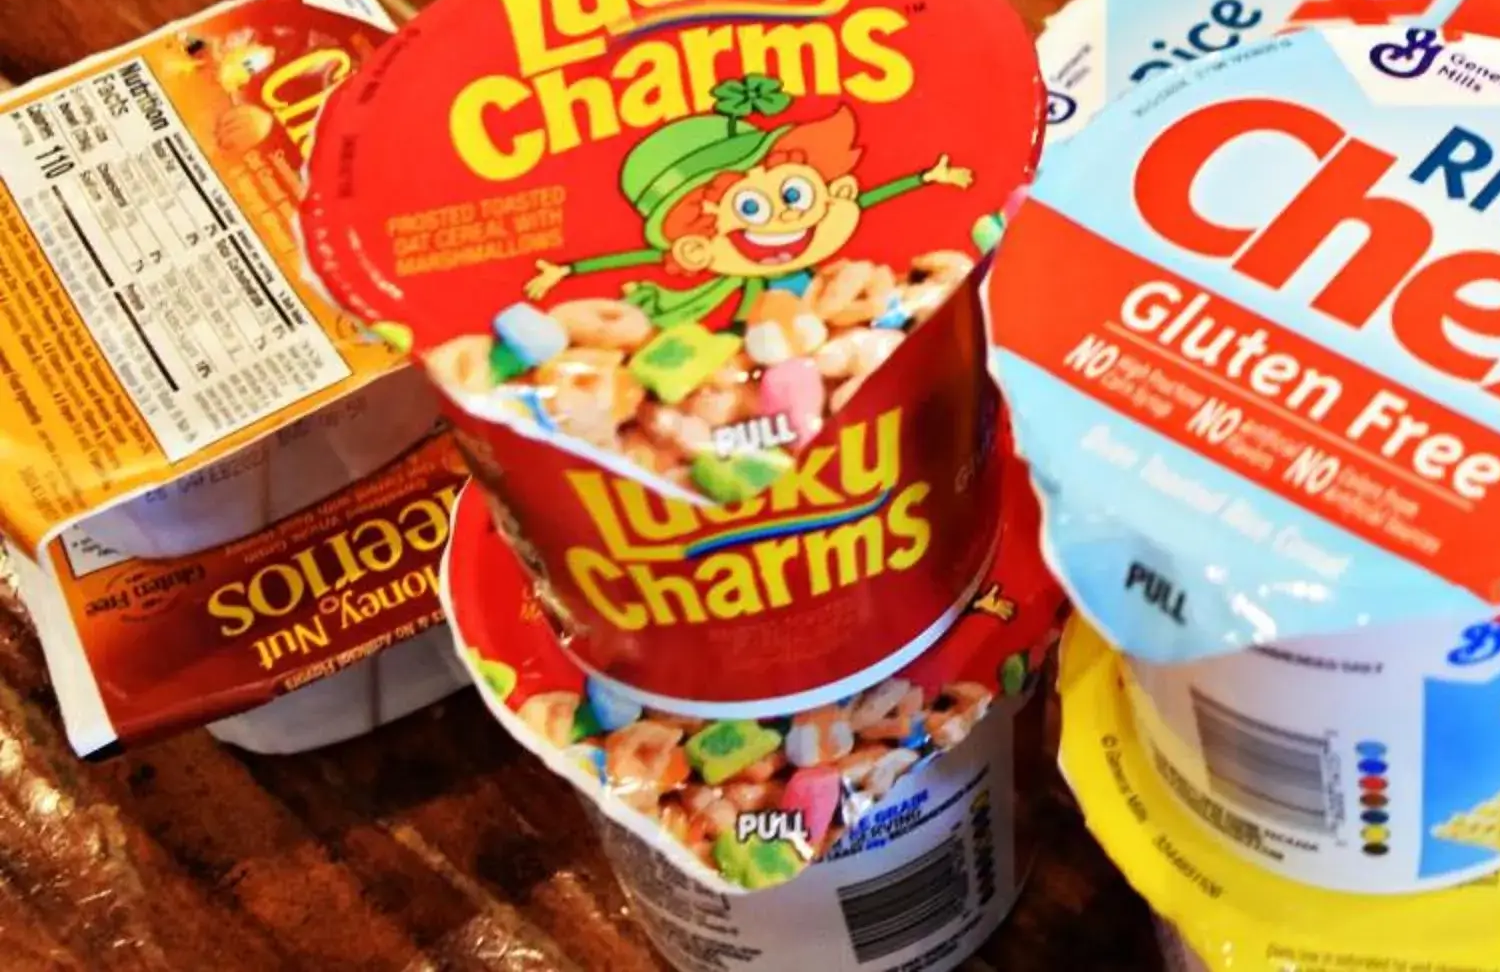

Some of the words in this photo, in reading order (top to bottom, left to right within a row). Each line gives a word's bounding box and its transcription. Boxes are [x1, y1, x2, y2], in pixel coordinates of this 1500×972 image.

[92, 71, 133, 120] Facts
[117, 59, 171, 134] Nutrition
[449, 7, 916, 181] Charms
[1437, 64, 1482, 93] Mills
[34, 141, 75, 181] 110
[1064, 333, 1116, 381] NO
[1121, 280, 1342, 420] Gluten
[713, 413, 797, 460] PULL
[1188, 396, 1241, 446] NO
[1284, 446, 1341, 496] NO
[206, 488, 468, 638] eerios
[564, 480, 932, 631] Charms
[85, 588, 132, 618] Free
[1124, 561, 1188, 625] PULL
[248, 613, 331, 671] Nut
[736, 809, 809, 842] PULL
